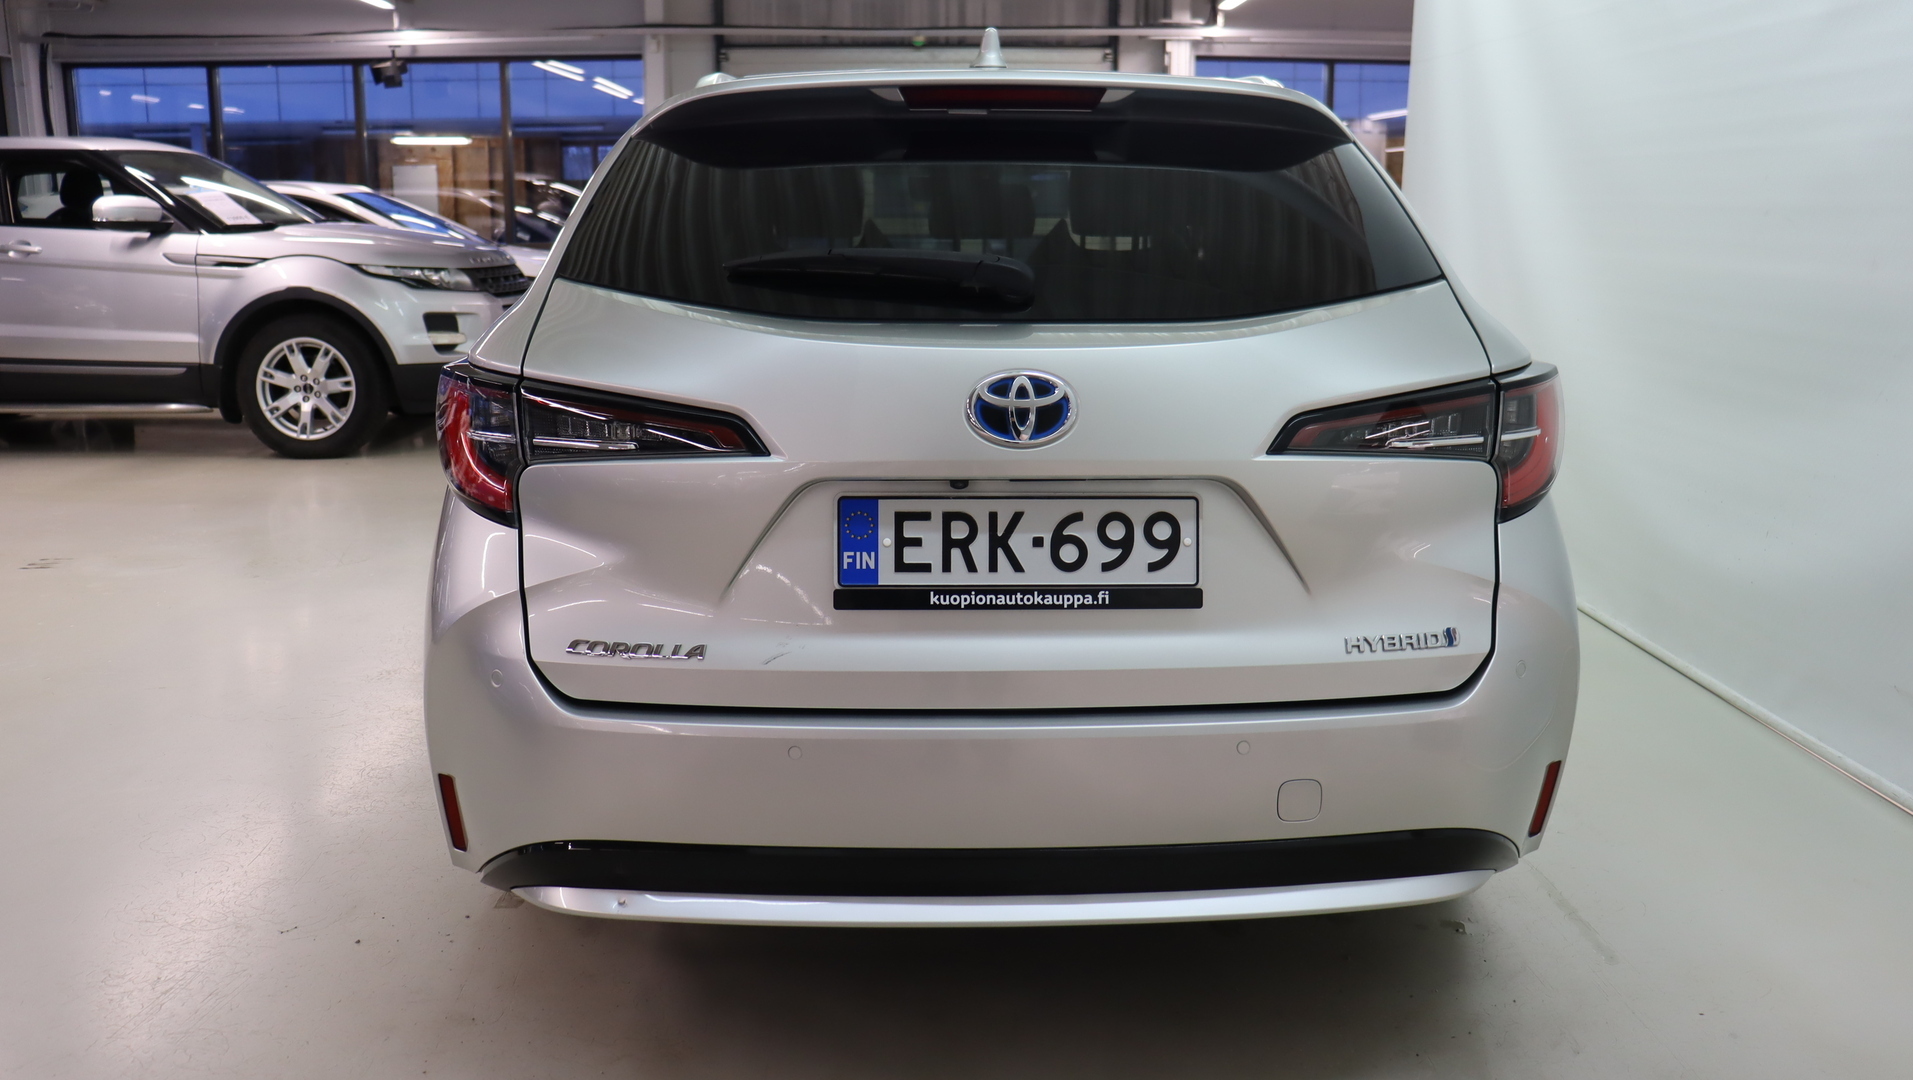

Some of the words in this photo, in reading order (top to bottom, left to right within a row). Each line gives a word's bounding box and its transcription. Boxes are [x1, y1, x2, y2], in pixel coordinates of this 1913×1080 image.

[843, 551, 876, 570] FIN
[929, 591, 1110, 608] kuopionautokauppa.fi
[565, 638, 707, 661] COROLLA
[1344, 632, 1445, 654] HYBRID
